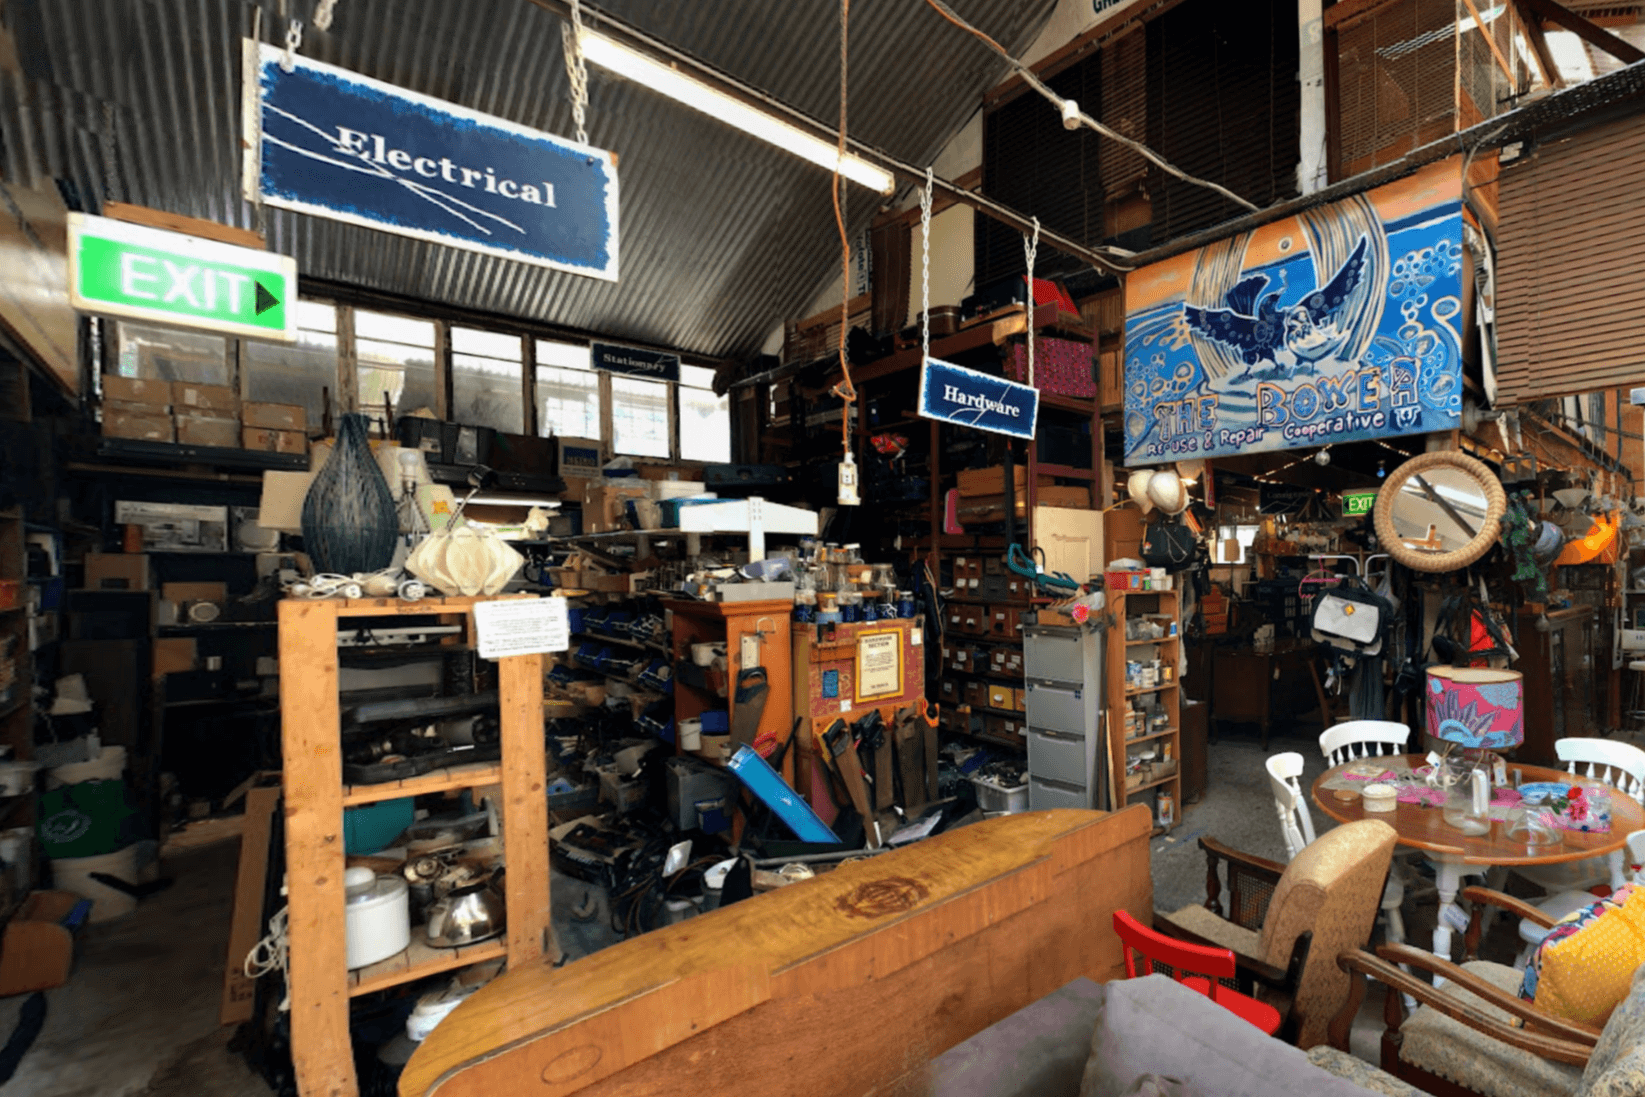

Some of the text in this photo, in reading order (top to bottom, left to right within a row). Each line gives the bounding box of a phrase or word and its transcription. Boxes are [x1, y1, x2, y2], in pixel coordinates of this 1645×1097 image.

[332, 125, 557, 209] Electrical
[121, 251, 251, 315] EXIT
[942, 384, 1021, 418] Hardware
[1153, 356, 1422, 442] THE BOWER
[1203, 430, 1216, 451] &
[1219, 425, 1268, 450] Repair
[1283, 411, 1385, 441] Cooperative
[1349, 496, 1375, 512] EXIT
